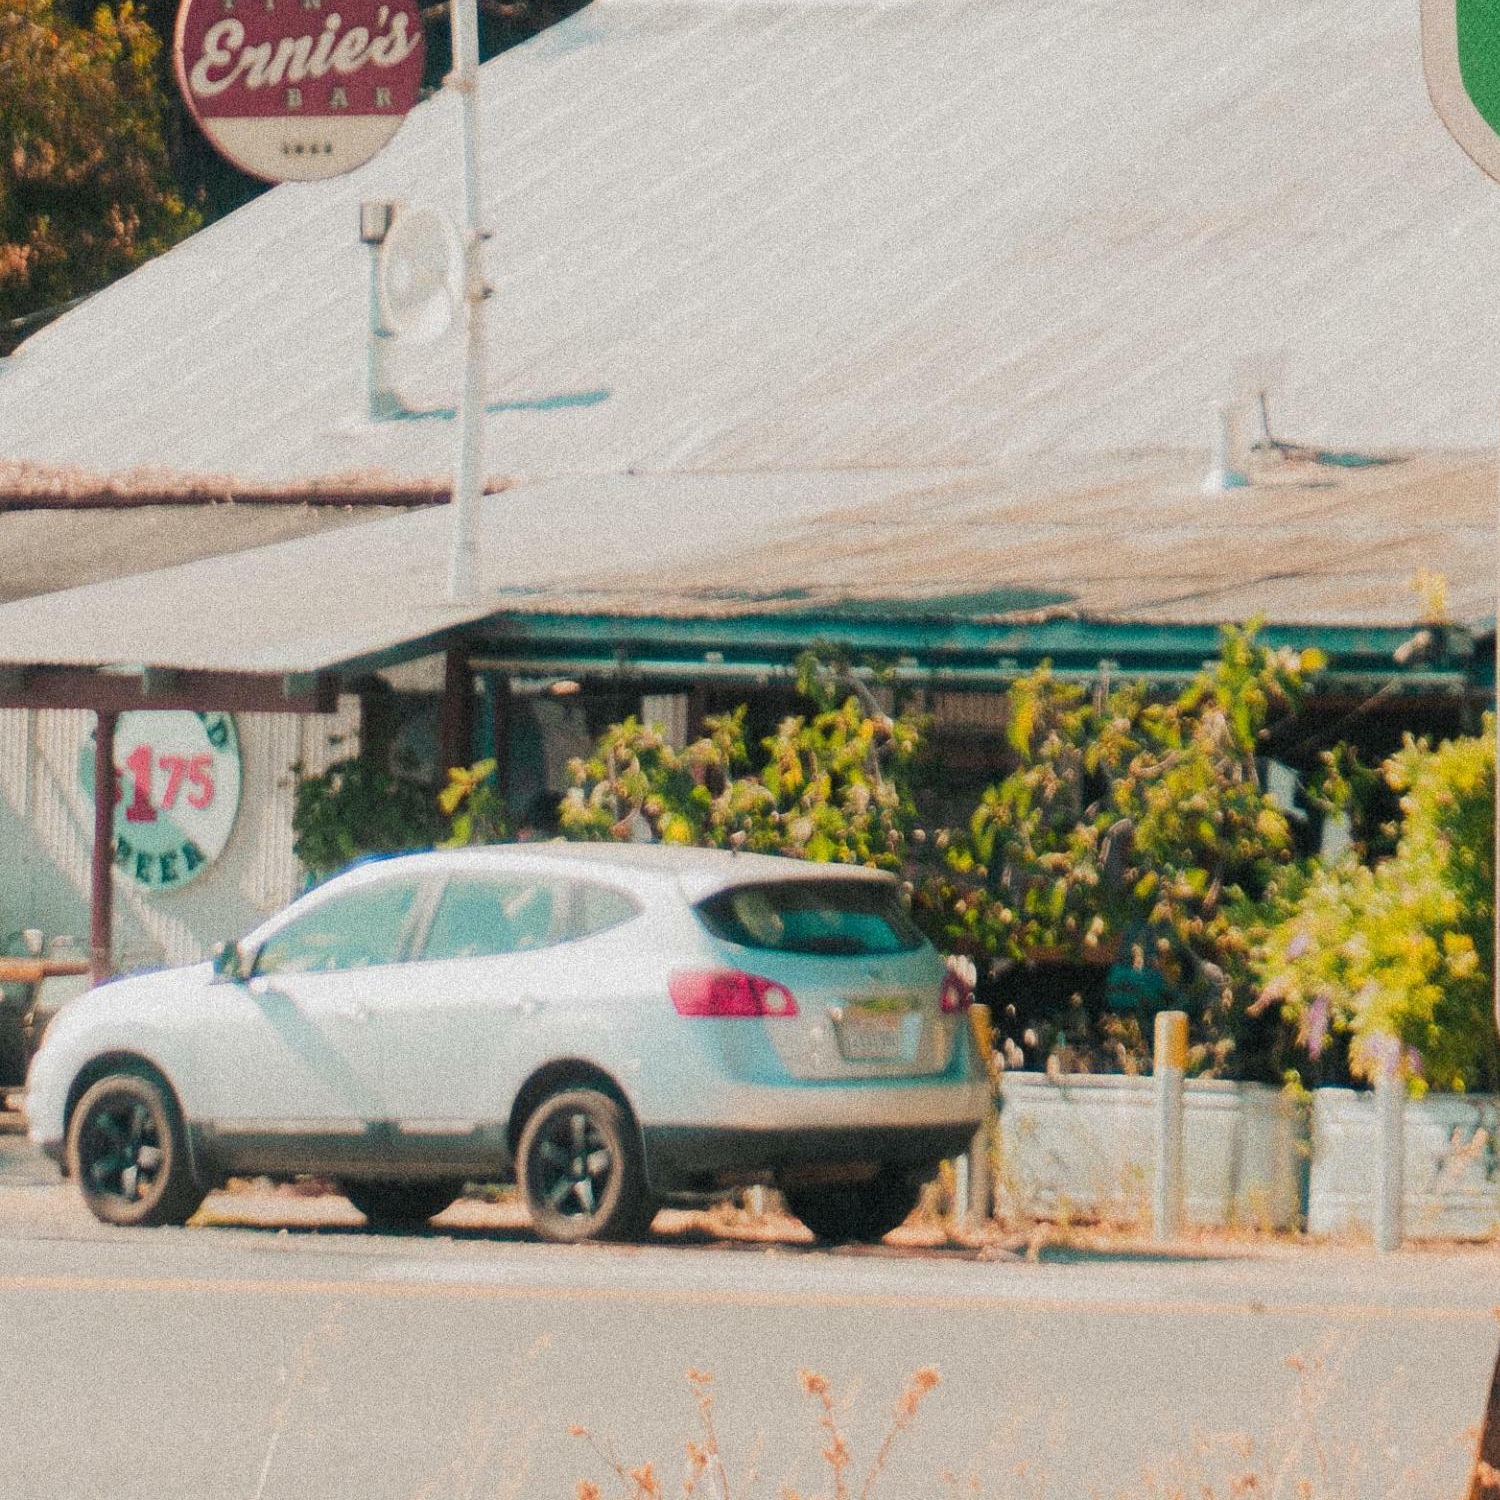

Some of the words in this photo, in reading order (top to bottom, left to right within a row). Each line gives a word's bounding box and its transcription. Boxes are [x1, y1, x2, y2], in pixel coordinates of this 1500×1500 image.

[190, 4, 422, 96] Ernie's
[284, 87, 392, 109] BAR
[115, 744, 216, 821] 175
